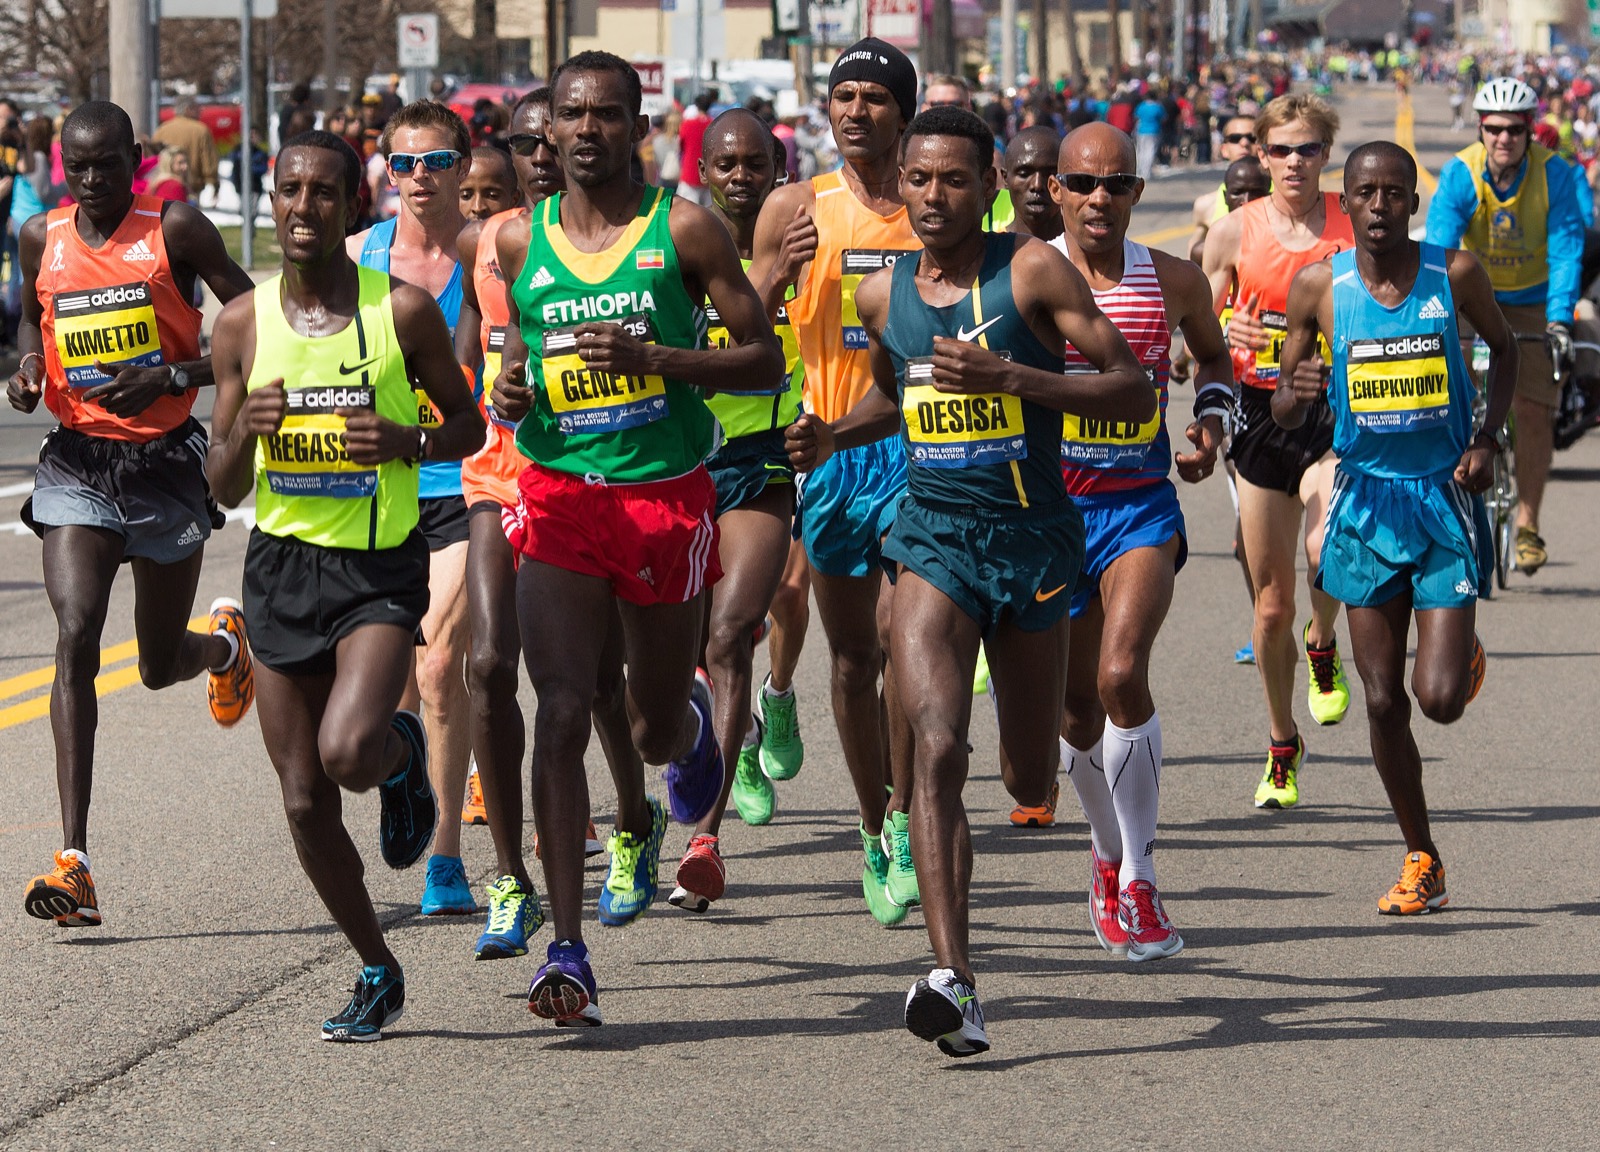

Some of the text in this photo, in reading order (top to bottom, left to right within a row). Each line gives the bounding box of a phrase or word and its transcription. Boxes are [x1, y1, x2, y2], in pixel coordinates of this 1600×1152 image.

[122, 253, 155, 262] adidas
[90, 286, 146, 307] adidas
[542, 290, 657, 324] ETHIOPIA
[1418, 309, 1449, 320] adidas
[64, 321, 150, 358] KIMETTO
[1385, 336, 1441, 355] adidas
[1352, 373, 1445, 400] CHEPKWONY
[305, 388, 370, 407] adidas
[574, 417, 610, 426] MARATHON
[587, 411, 609, 419] BOSTON
[917, 396, 1009, 434] DESISA
[268, 430, 351, 463] REGASS
[928, 452, 966, 460] MARATHON
